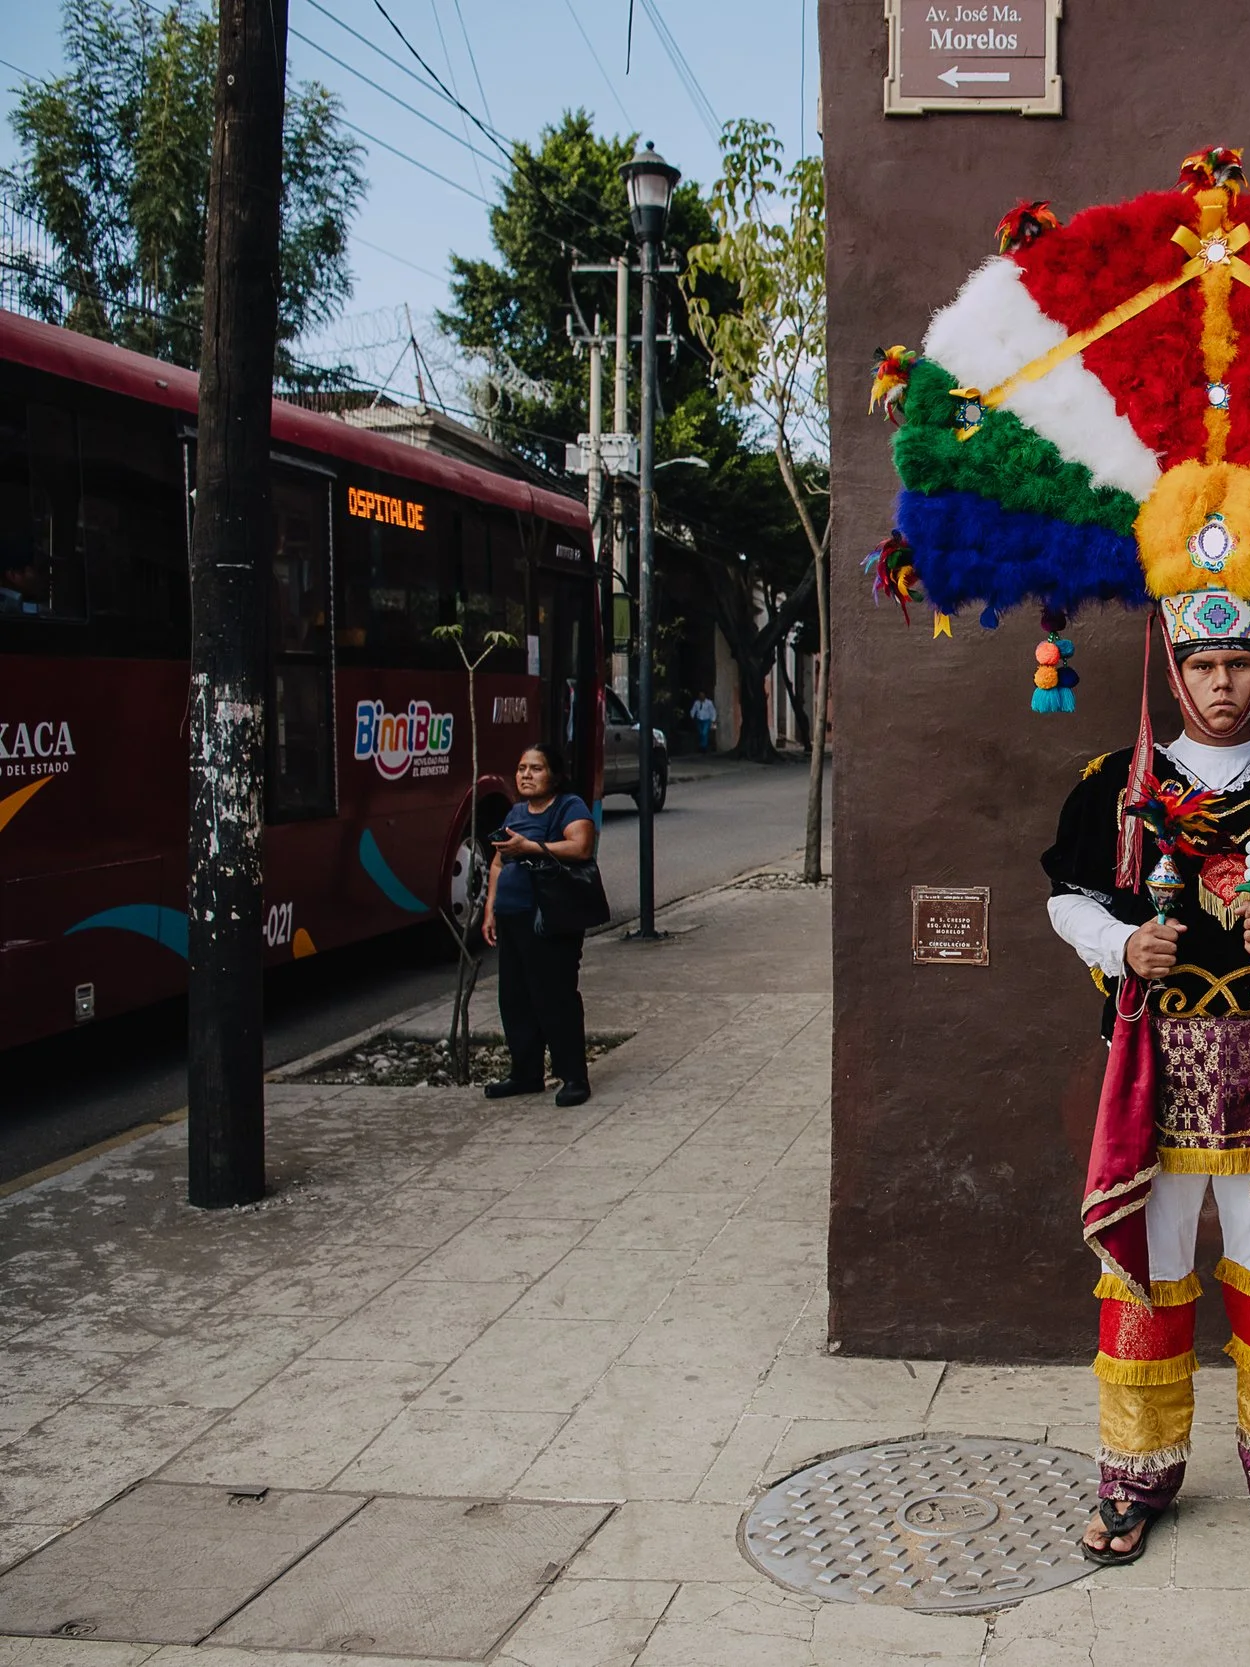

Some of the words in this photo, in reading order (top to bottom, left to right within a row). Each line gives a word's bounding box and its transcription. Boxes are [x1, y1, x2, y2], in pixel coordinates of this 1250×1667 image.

[925, 6, 950, 22] Av.
[954, 5, 988, 22] José
[992, 6, 1022, 22] Ma.
[929, 28, 1018, 50] Morelos
[355, 699, 453, 760] BinniBus
[7, 764, 26, 776] DEL
[30, 762, 69, 775] ESTADO
[412, 767, 421, 777] EL
[420, 765, 449, 776] BIENESTAR
